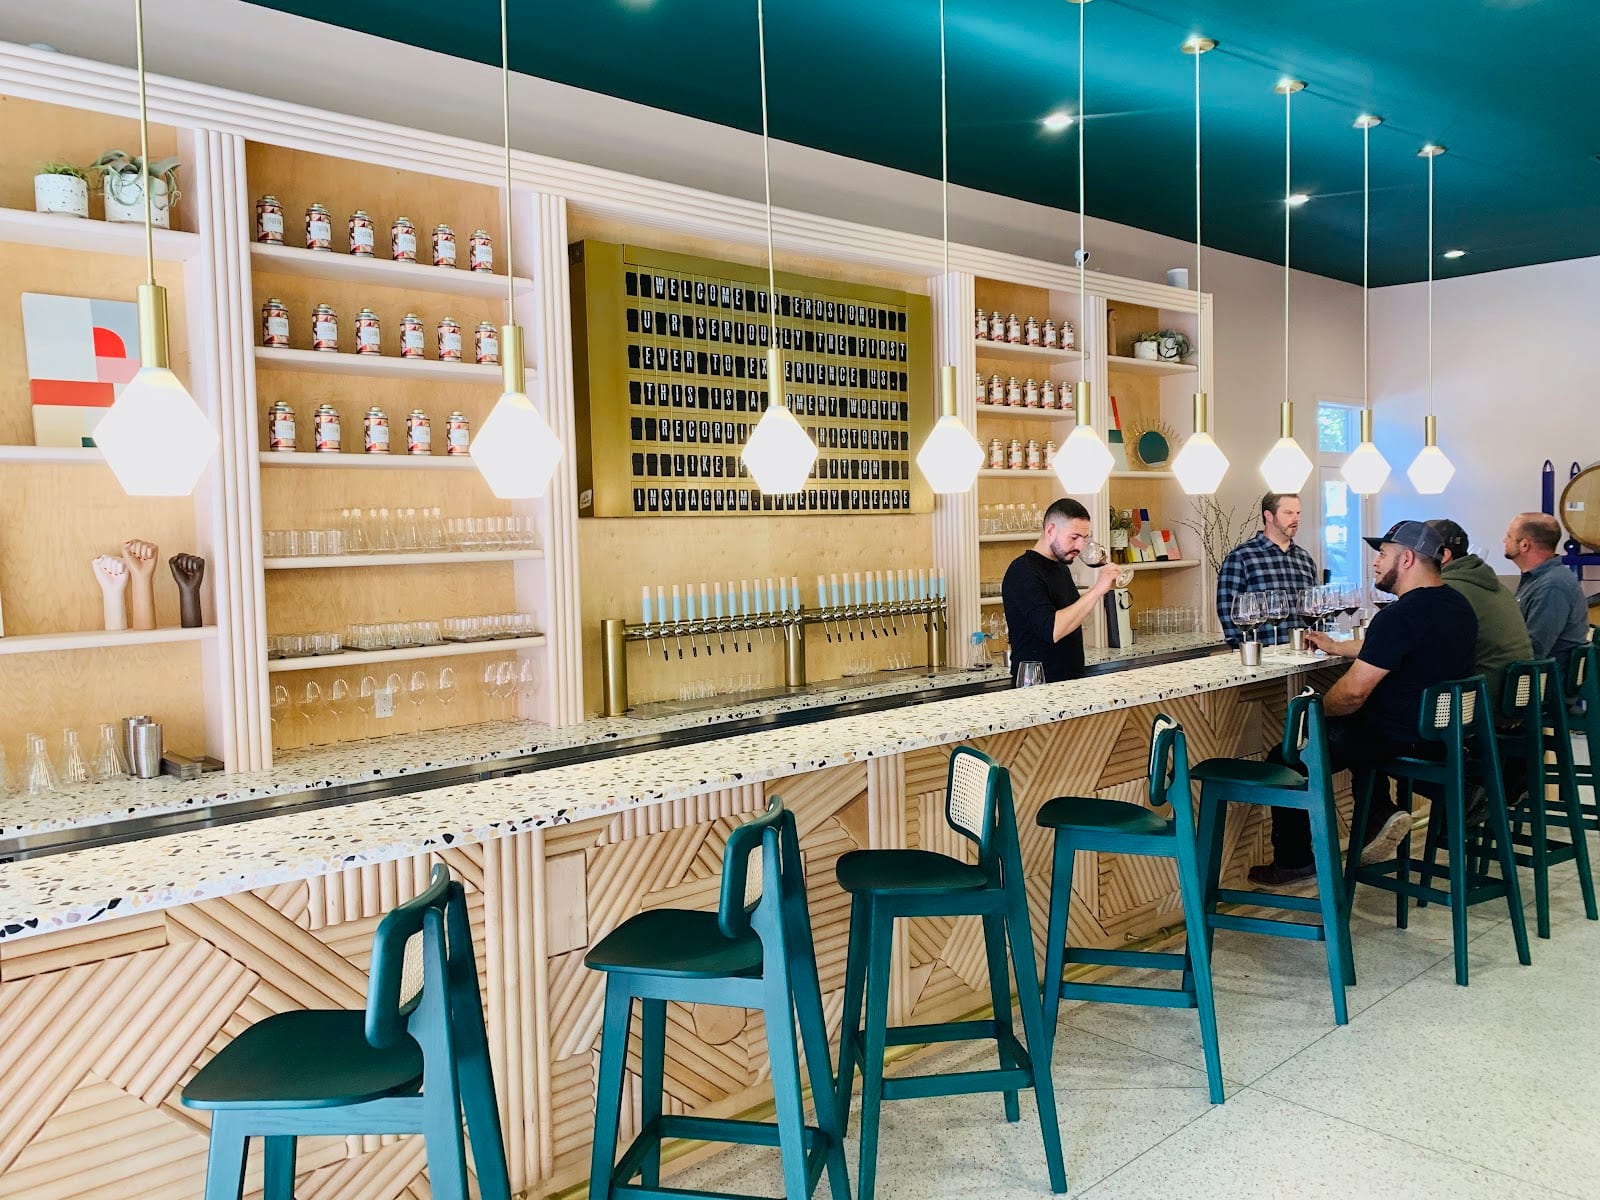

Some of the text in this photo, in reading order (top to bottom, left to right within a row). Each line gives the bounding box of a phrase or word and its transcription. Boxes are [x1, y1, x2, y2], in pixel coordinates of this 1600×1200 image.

[655, 276, 741, 305] WELCOME
[794, 298, 874, 324] EROSION!
[644, 311, 905, 358] U R SERIOULY THE FIRST
[645, 347, 895, 387] EVER TO EXERIENCE US.
[646, 383, 694, 403] THIS
[714, 389, 732, 406] IS
[750, 392, 757, 407] A
[850, 398, 897, 417] WORTH
[819, 428, 896, 445] HISTORY,
[676, 455, 721, 472] LIKE
[832, 460, 847, 475] IT
[862, 461, 878, 475] ON
[637, 489, 908, 506] INSTAGRAM. PRETTY PLEASE
